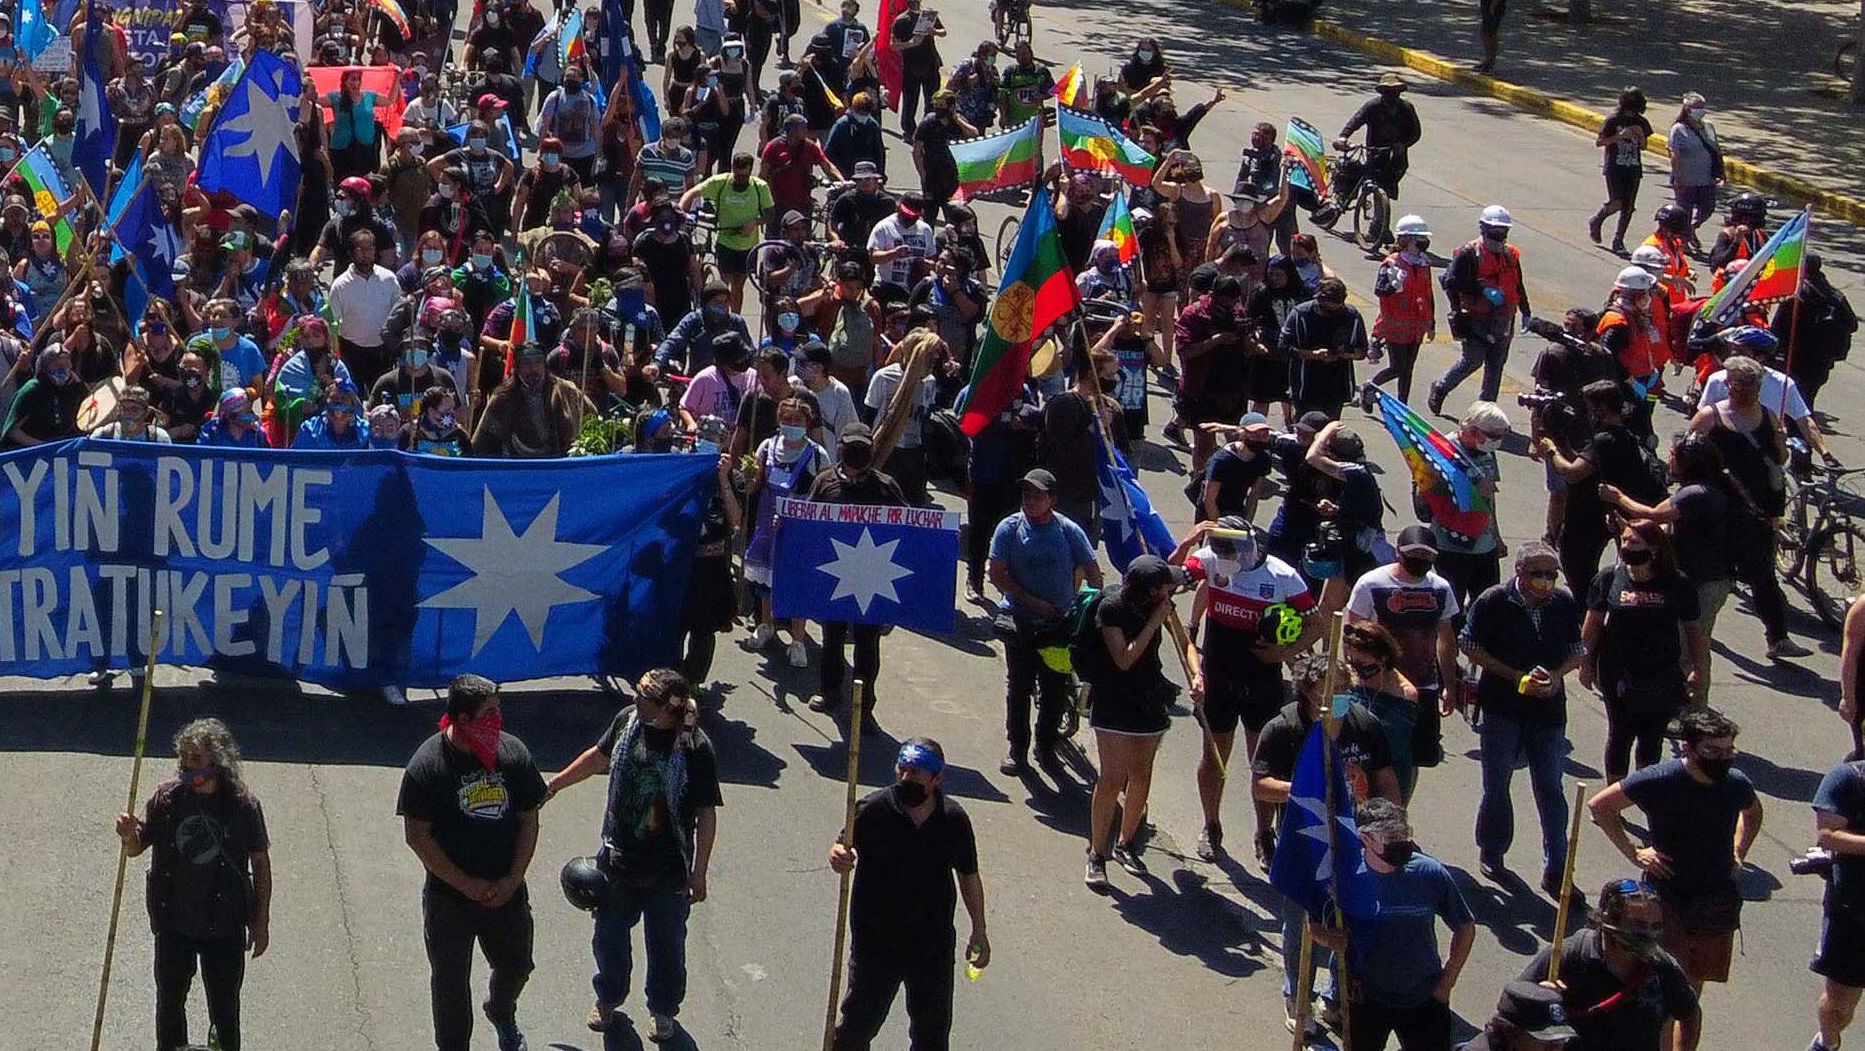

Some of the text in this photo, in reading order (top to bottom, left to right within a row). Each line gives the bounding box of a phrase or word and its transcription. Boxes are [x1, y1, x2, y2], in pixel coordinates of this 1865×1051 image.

[156, 455, 333, 570] RUME
[819, 505, 834, 521] AL
[839, 505, 882, 524] MAPUCHE
[905, 509, 943, 529] LUCHAR
